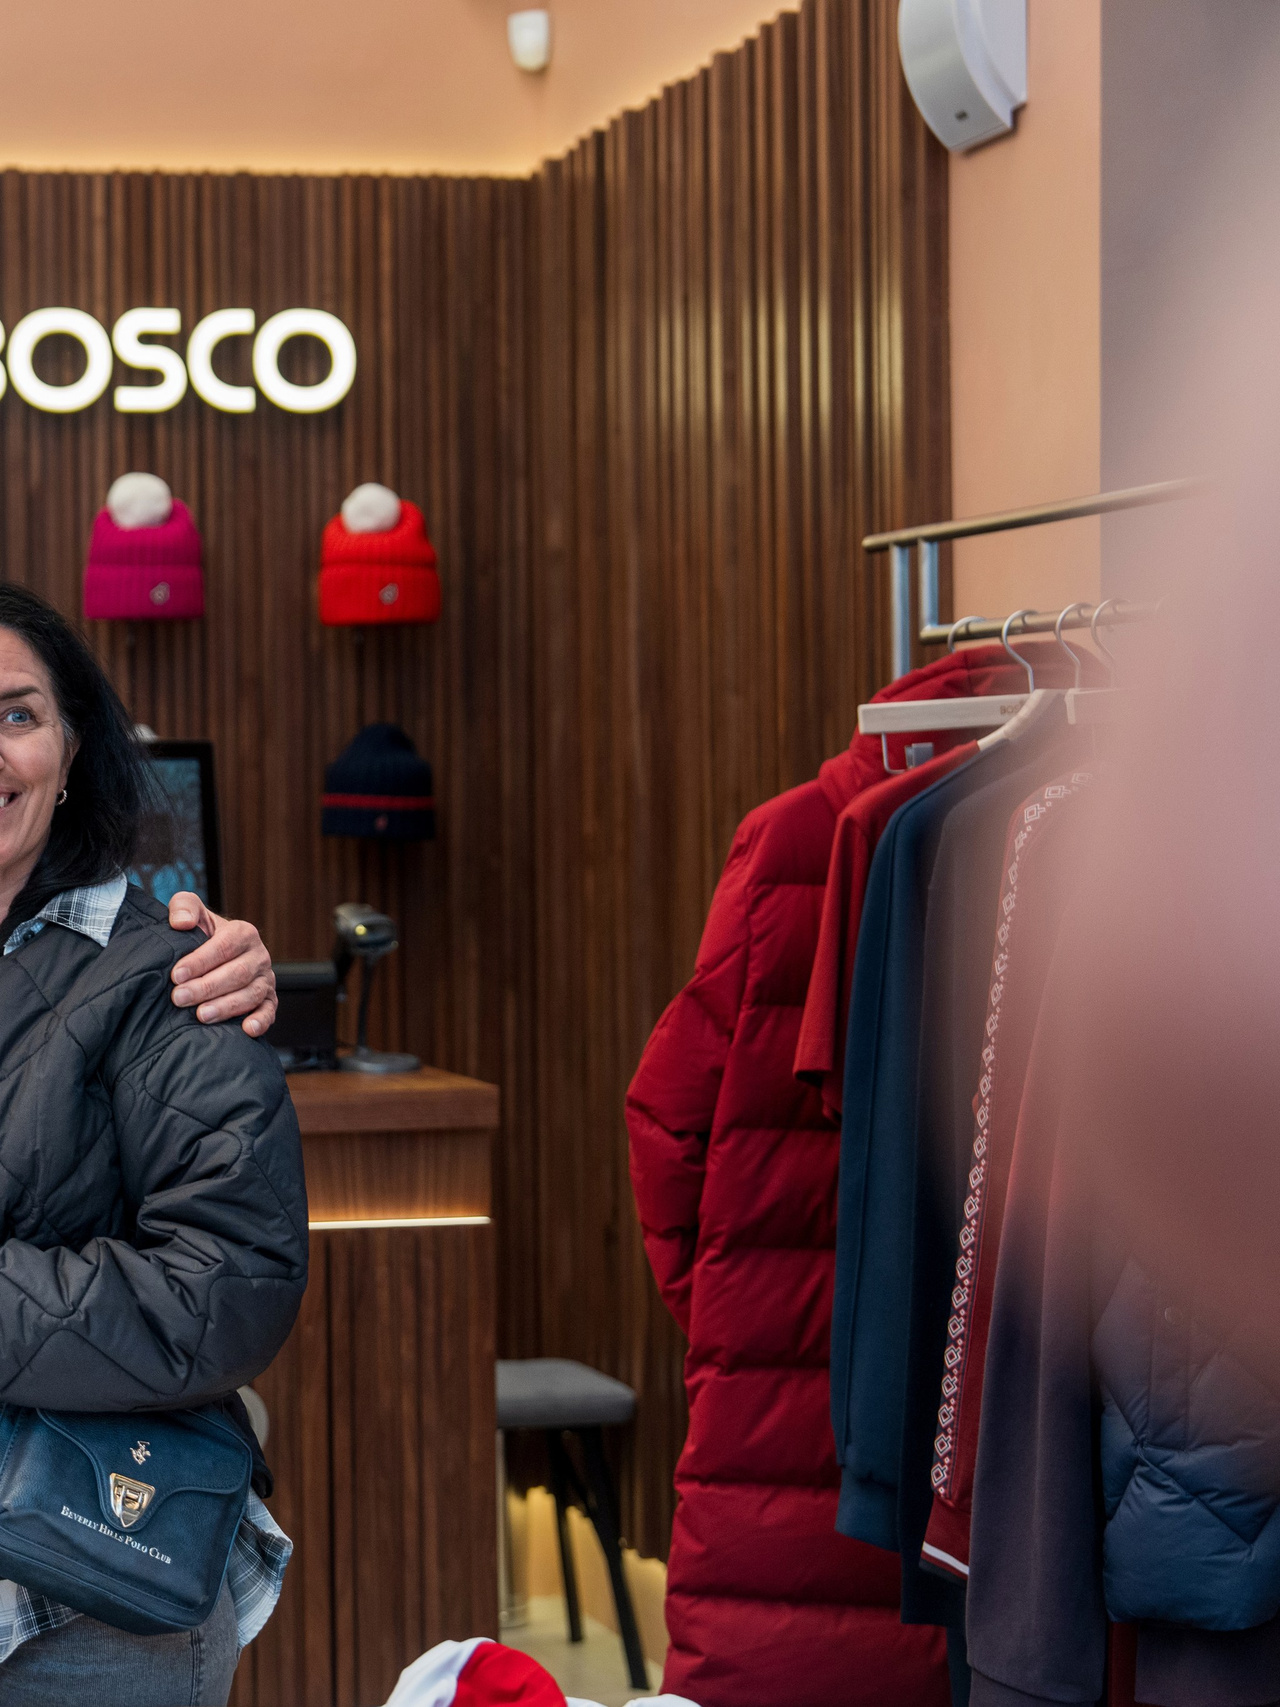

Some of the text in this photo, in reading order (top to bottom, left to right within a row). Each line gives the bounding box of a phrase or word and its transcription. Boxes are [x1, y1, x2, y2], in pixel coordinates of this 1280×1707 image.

[60, 1505, 172, 1565] BEVERLY HILLS POLO CLUB
